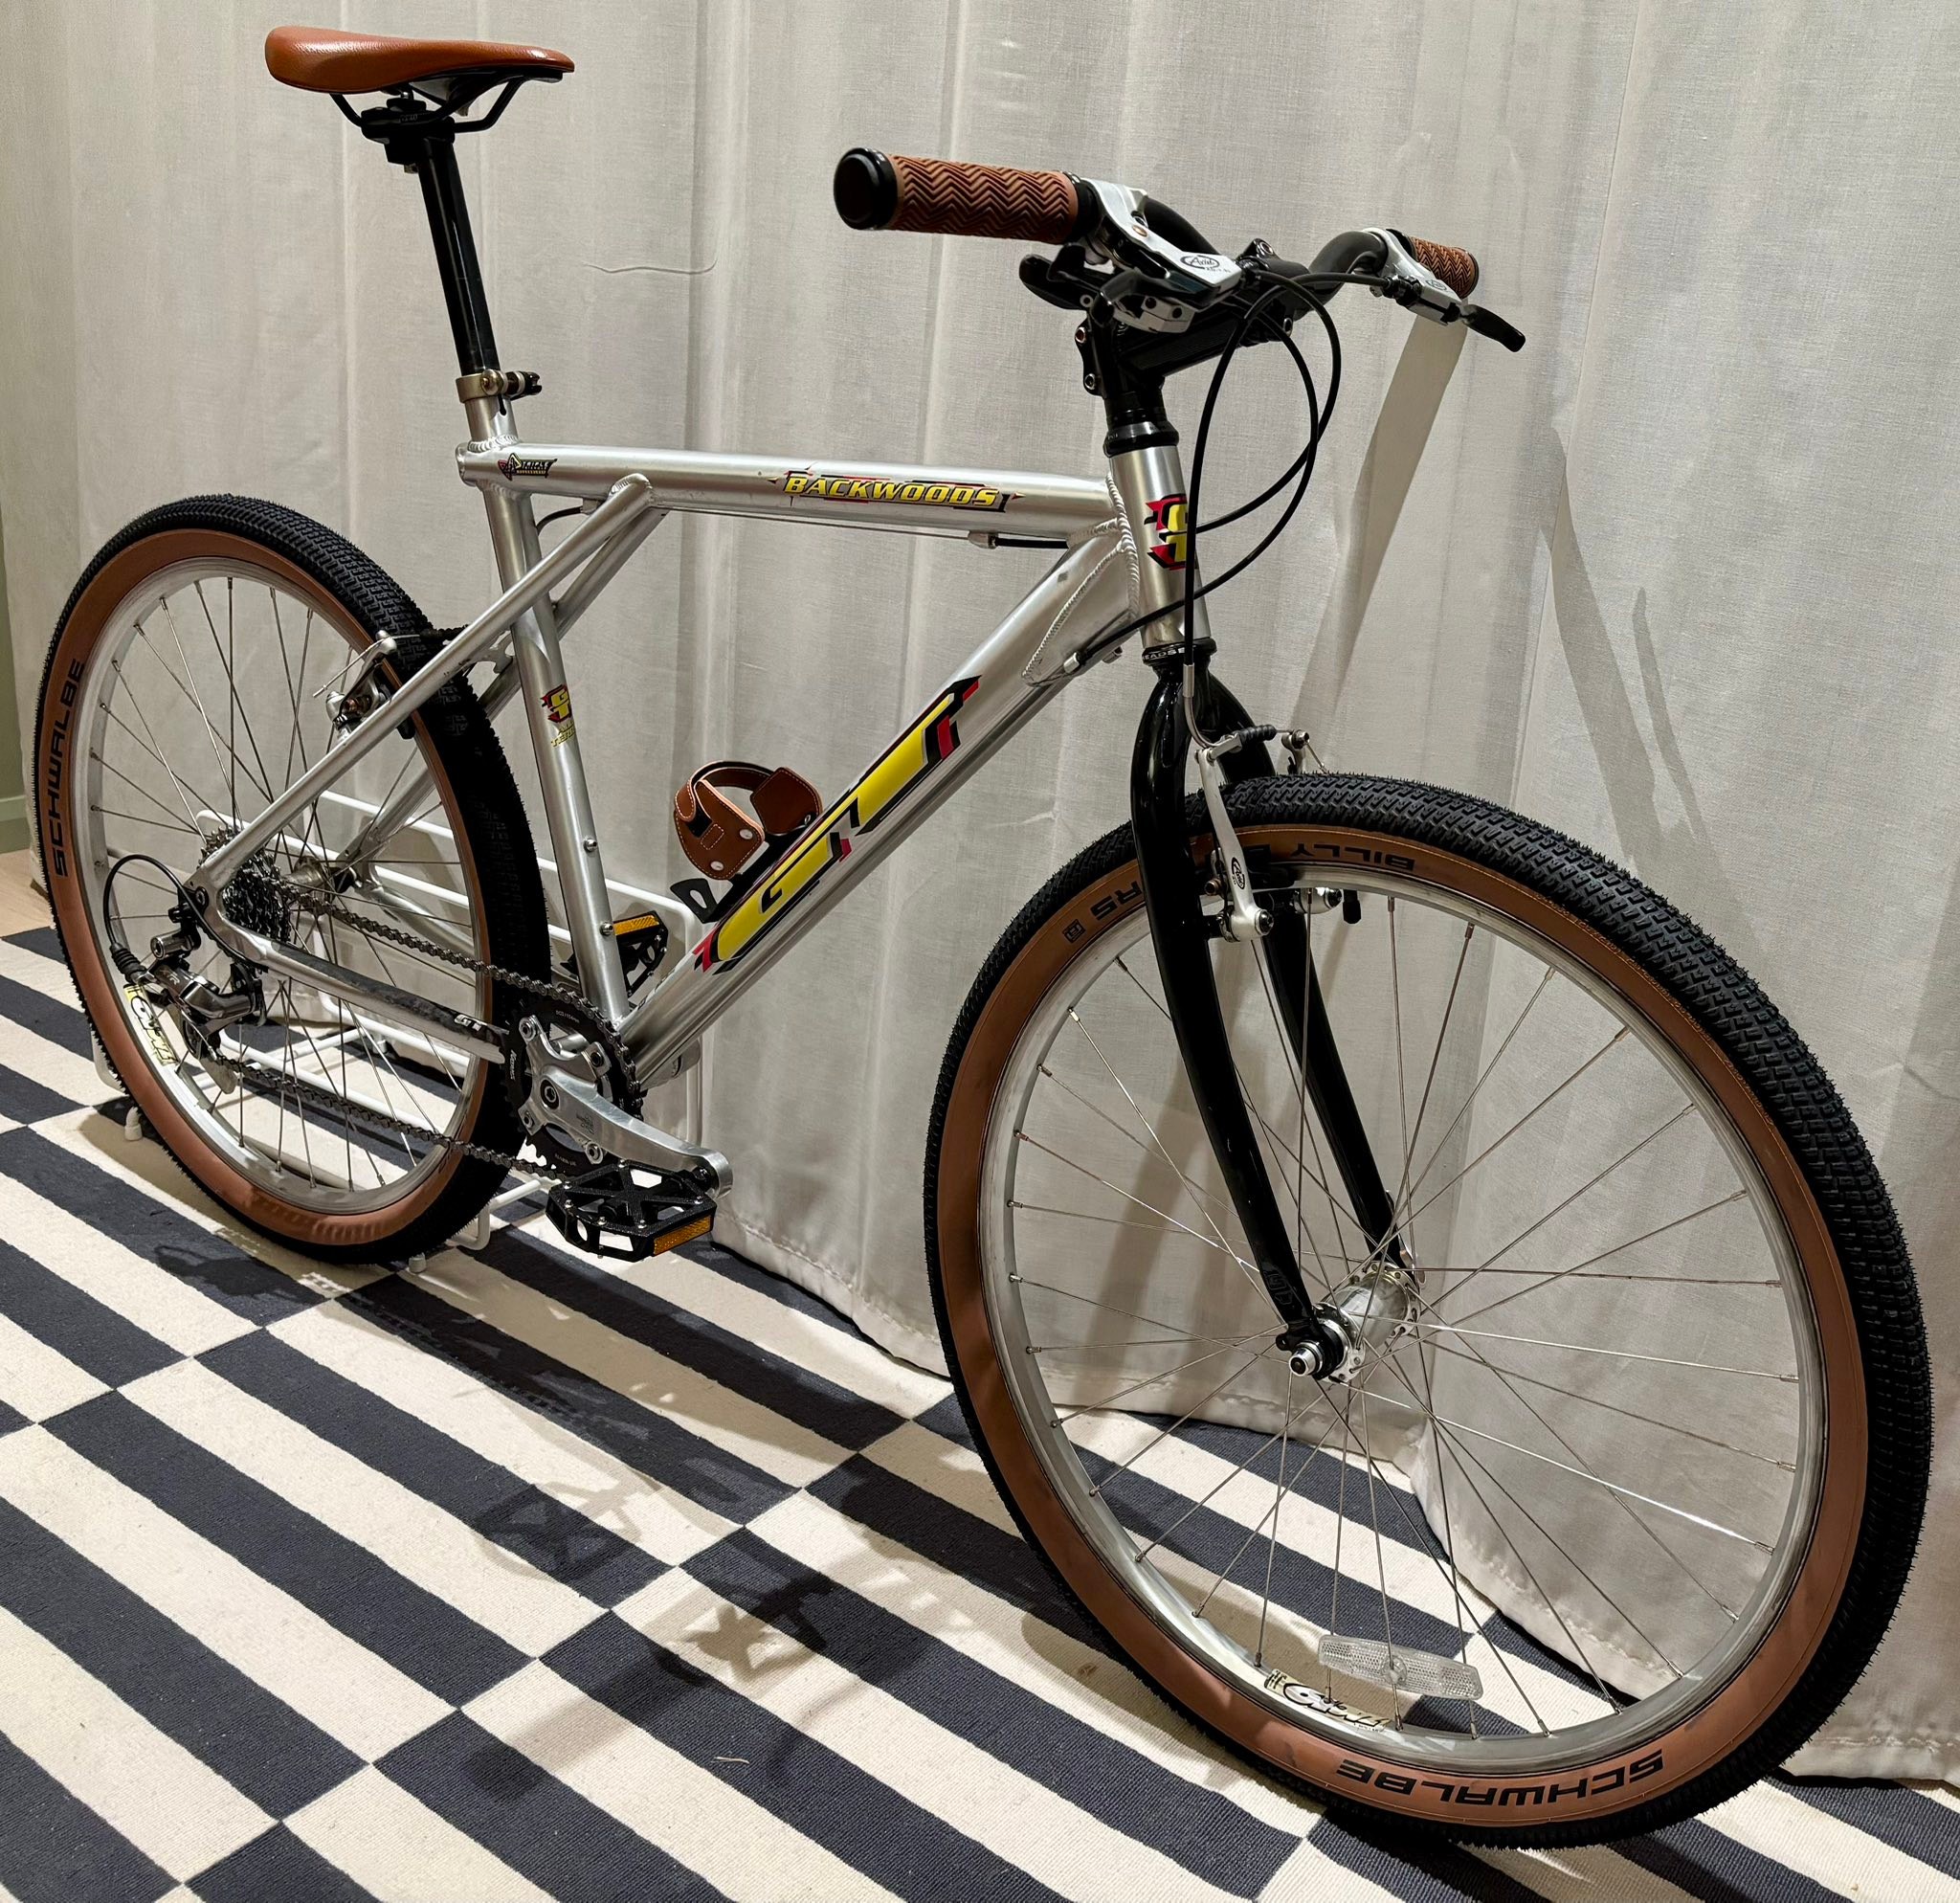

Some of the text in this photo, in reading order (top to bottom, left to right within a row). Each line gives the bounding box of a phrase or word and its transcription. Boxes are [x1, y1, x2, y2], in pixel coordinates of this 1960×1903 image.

[783, 475, 1001, 507] BACKWOODS
[48, 658, 84, 877] SCHWALBE
[701, 680, 971, 969] GT
[1290, 842, 1415, 871] BILLY
[1336, 1749, 1665, 1806] SCHWALBE
